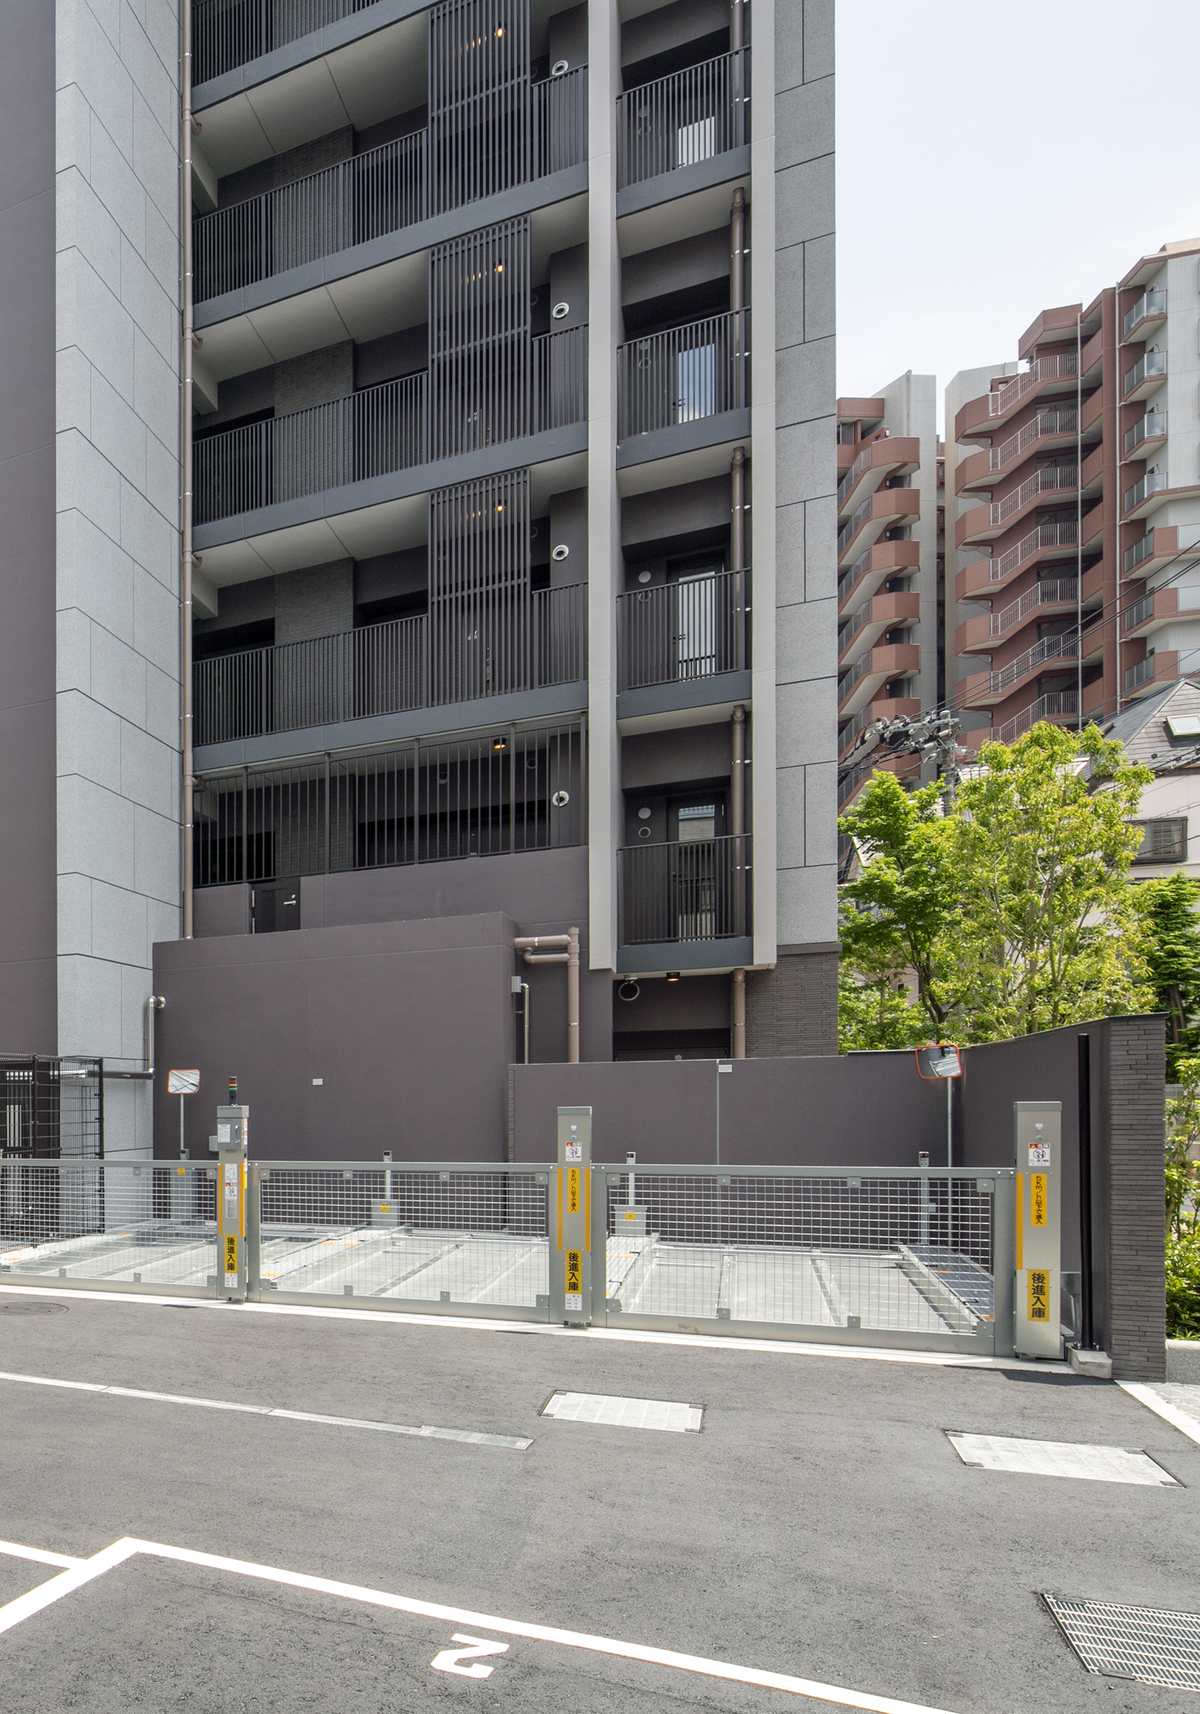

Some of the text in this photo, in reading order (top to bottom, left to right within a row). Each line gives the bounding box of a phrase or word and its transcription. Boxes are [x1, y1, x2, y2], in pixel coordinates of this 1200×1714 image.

[227, 1236, 236, 1271] 後進入庫
[568, 1252, 580, 1292] 後進入庫
[1031, 1272, 1046, 1319] 後進入庫
[430, 1632, 510, 1679] 2
